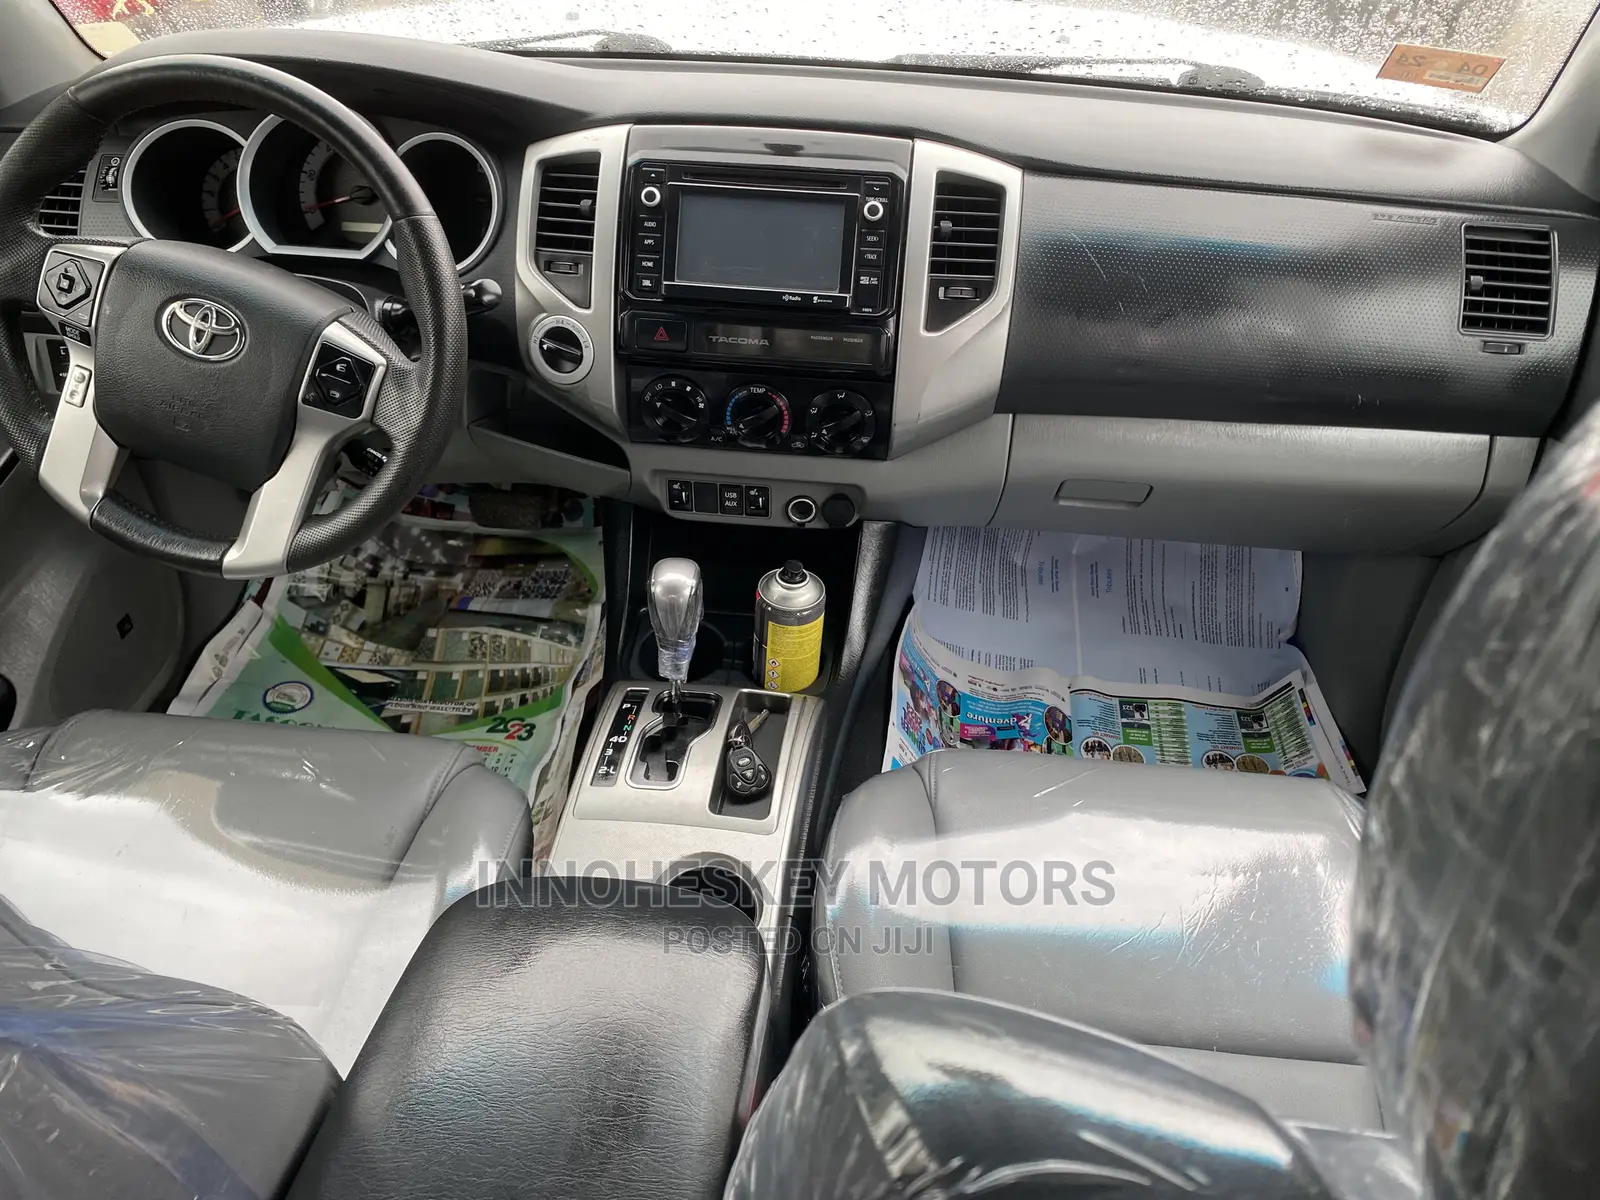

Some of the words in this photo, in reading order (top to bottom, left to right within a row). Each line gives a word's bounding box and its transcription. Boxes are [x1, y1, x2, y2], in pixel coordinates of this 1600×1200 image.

[643, 220, 657, 228] AUDIO
[641, 260, 654, 268] HOME
[708, 335, 770, 346] TACOMA
[654, 383, 663, 391] LO
[750, 386, 766, 394] TEMP
[486, 716, 536, 741] 2023
[604, 748, 613, 756] 3
